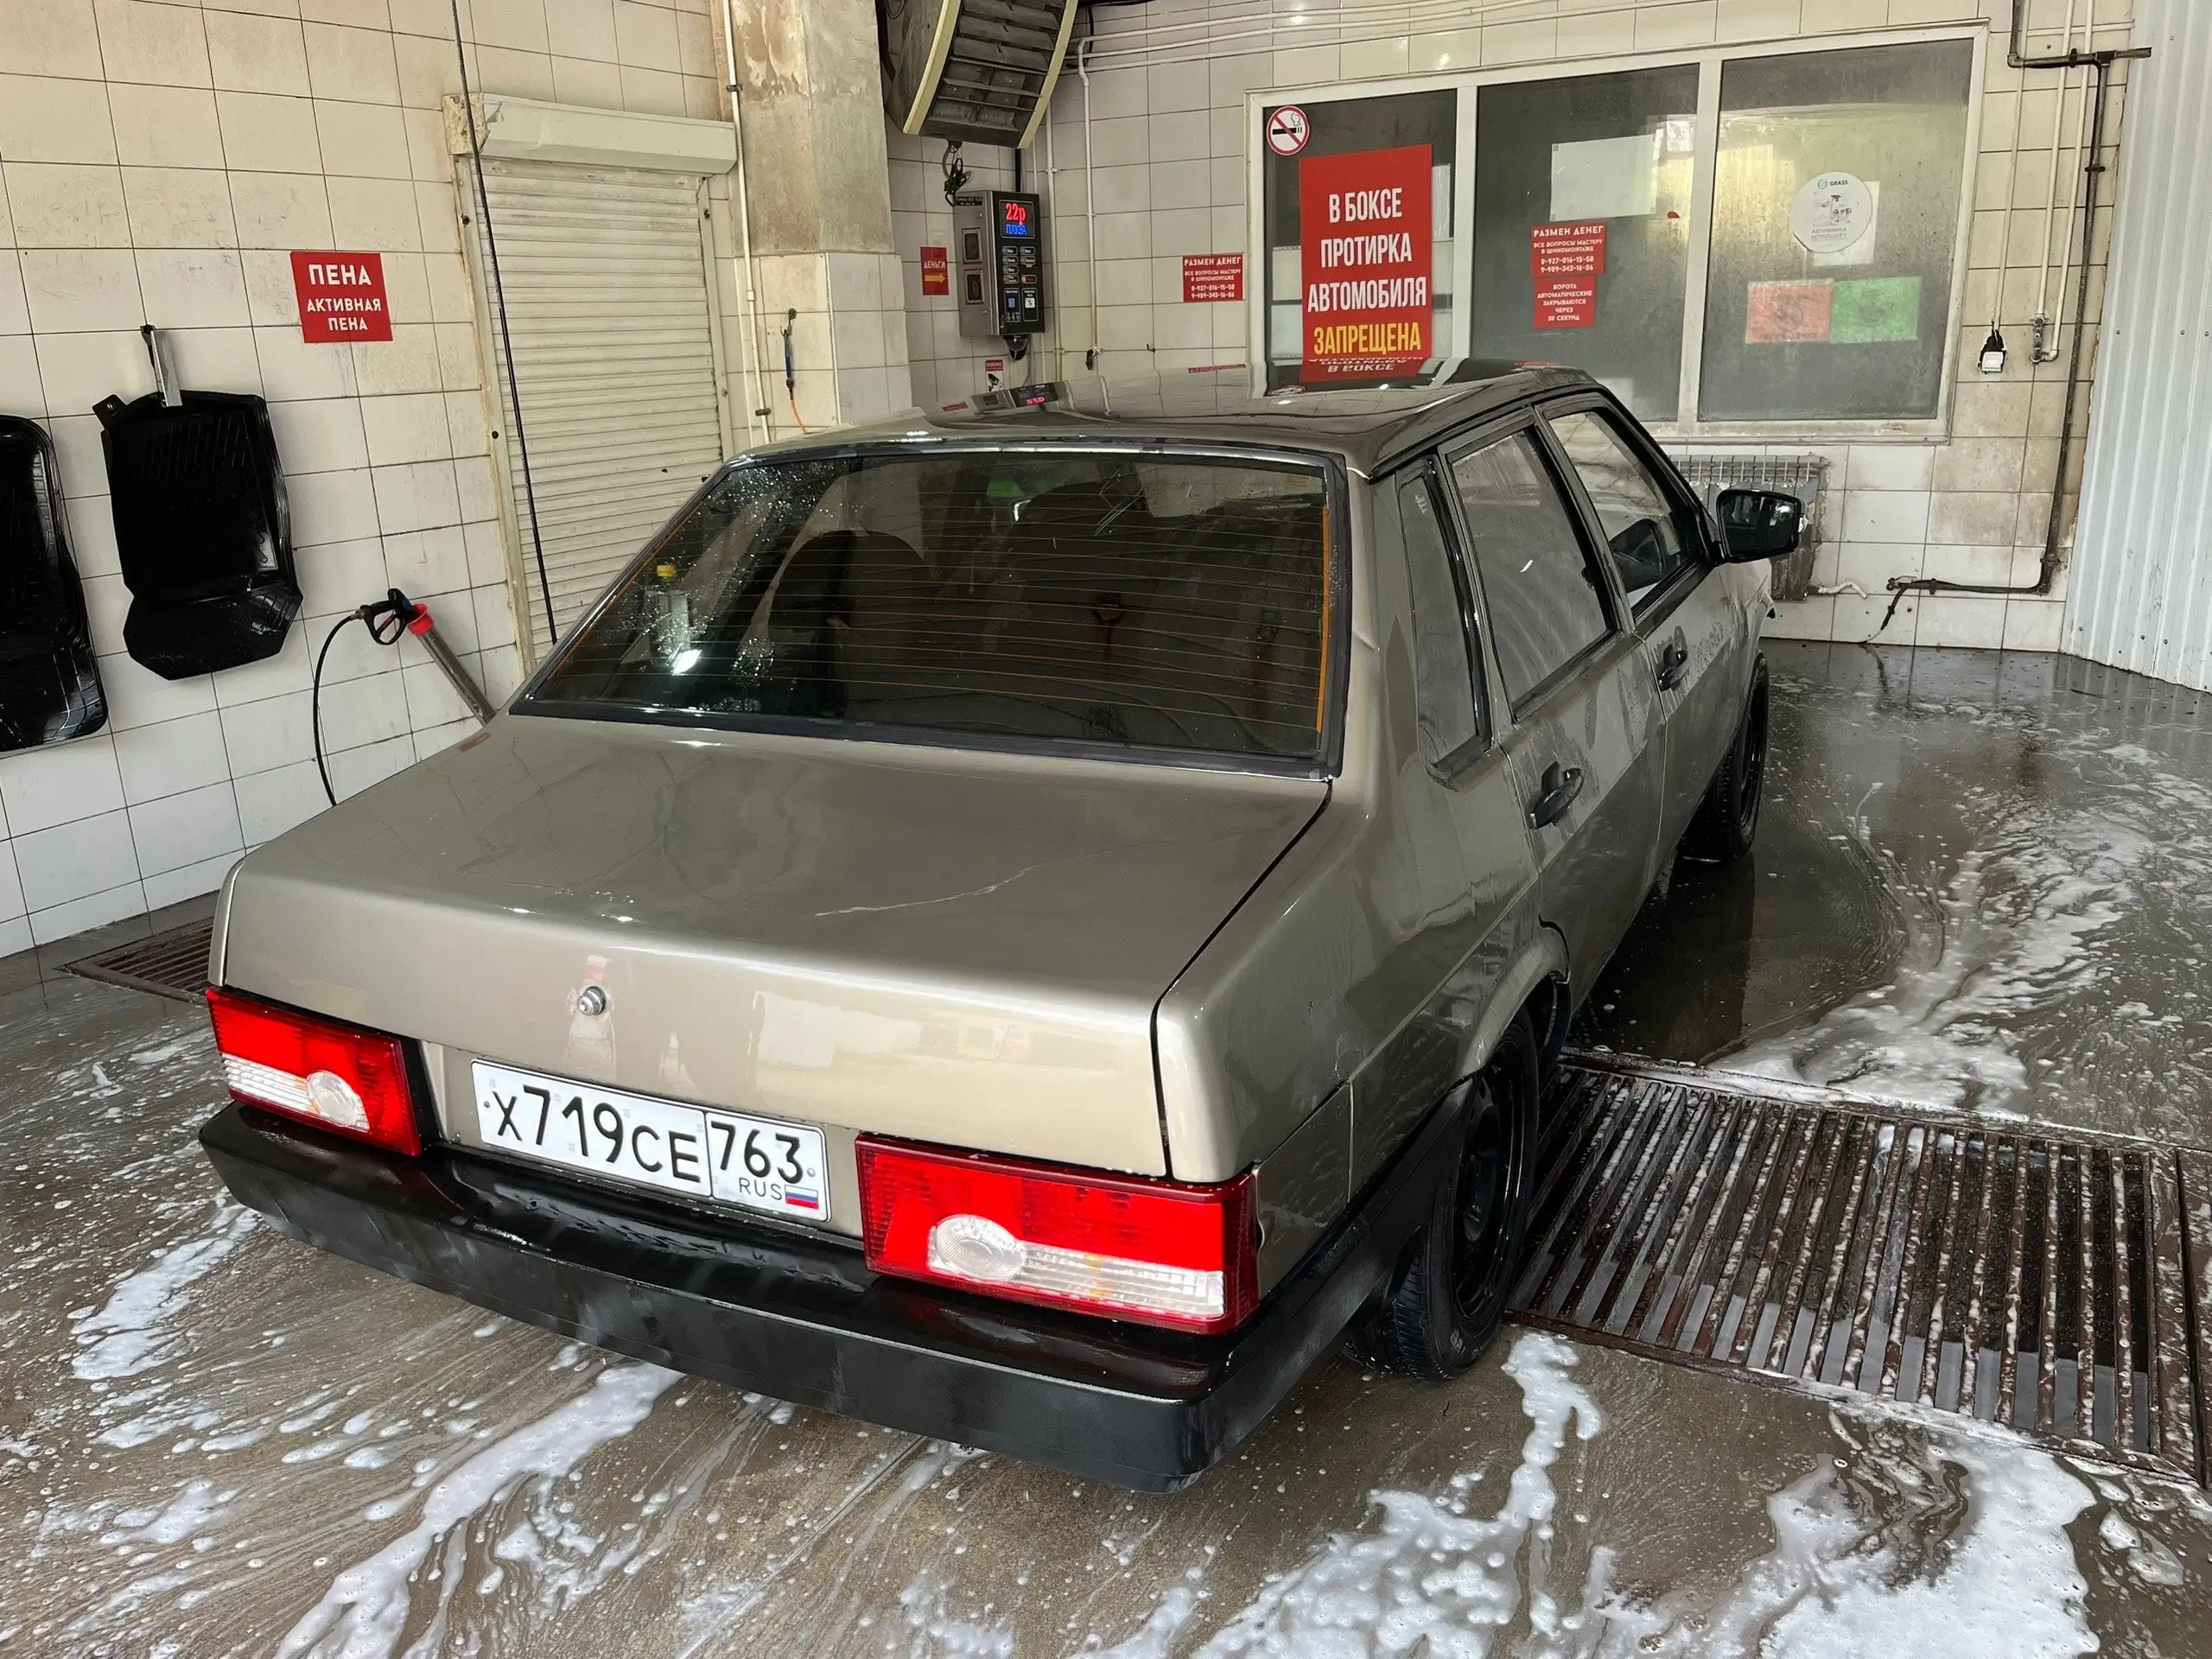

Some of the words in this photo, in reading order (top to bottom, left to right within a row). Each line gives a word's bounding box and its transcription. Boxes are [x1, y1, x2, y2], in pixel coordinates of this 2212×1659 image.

[1329, 194, 1340, 223] В
[1344, 188, 1402, 222] БОКСЕ
[1533, 227, 1571, 238] РАЗМЕН
[1573, 226, 1604, 236] ДЕНЕГ
[1320, 232, 1413, 268] ПРОТИРКА
[923, 260, 946, 270] ДЕНЬГИ
[1184, 257, 1214, 266] РАЗМЕН
[1216, 257, 1242, 266] ДЕНЕГ
[308, 264, 372, 285] ПЕНА
[307, 297, 382, 312] АКТИВНАЯ
[1307, 276, 1427, 313] АВТОМОБИЛЯ
[1536, 290, 1592, 299] АВТОМАТИЧЕСКИЕ
[327, 317, 368, 331] ПЕНА
[1313, 321, 1421, 355] ЗАПРЕЩЕНА
[710, 1120, 804, 1185] 763
[738, 1177, 784, 1201] RUS
